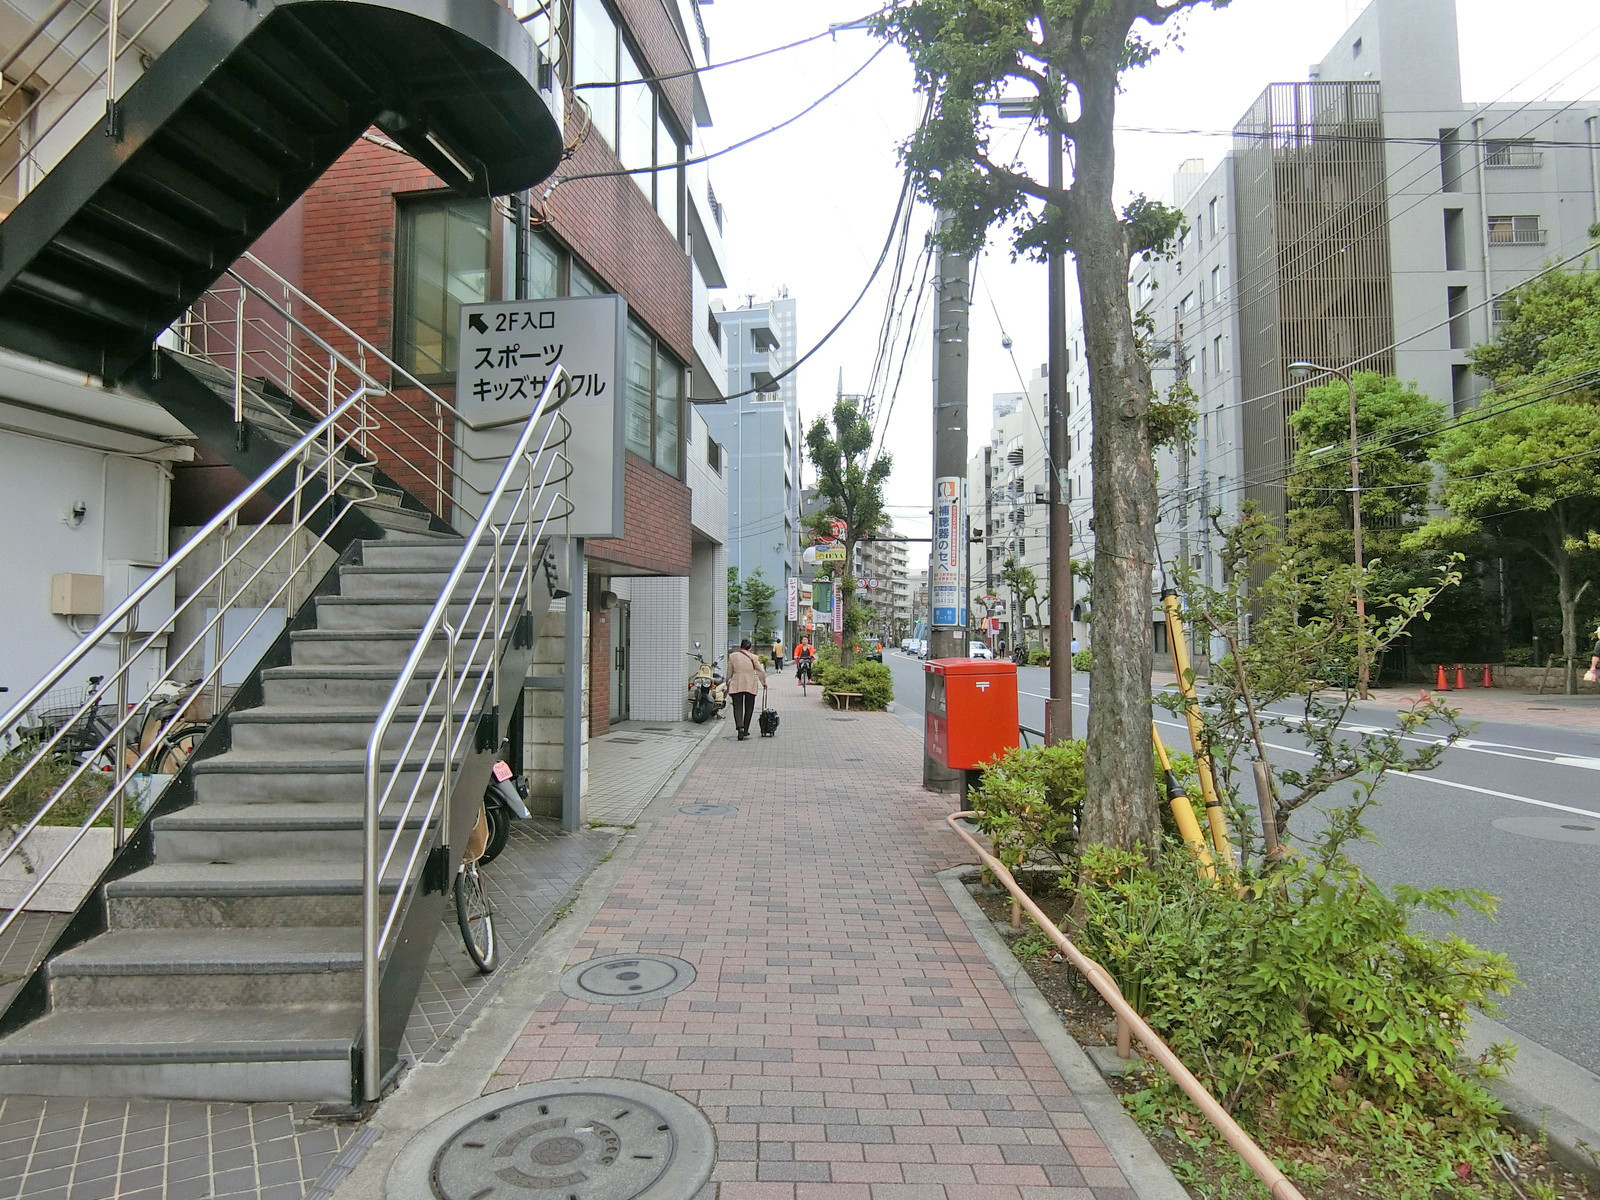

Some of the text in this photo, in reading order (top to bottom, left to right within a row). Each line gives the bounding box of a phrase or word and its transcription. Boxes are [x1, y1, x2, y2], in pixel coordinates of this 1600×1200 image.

[495, 311, 555, 332] 2F入口
[474, 343, 564, 370] スポーツ
[938, 505, 949, 571] 補聴器のセベ
